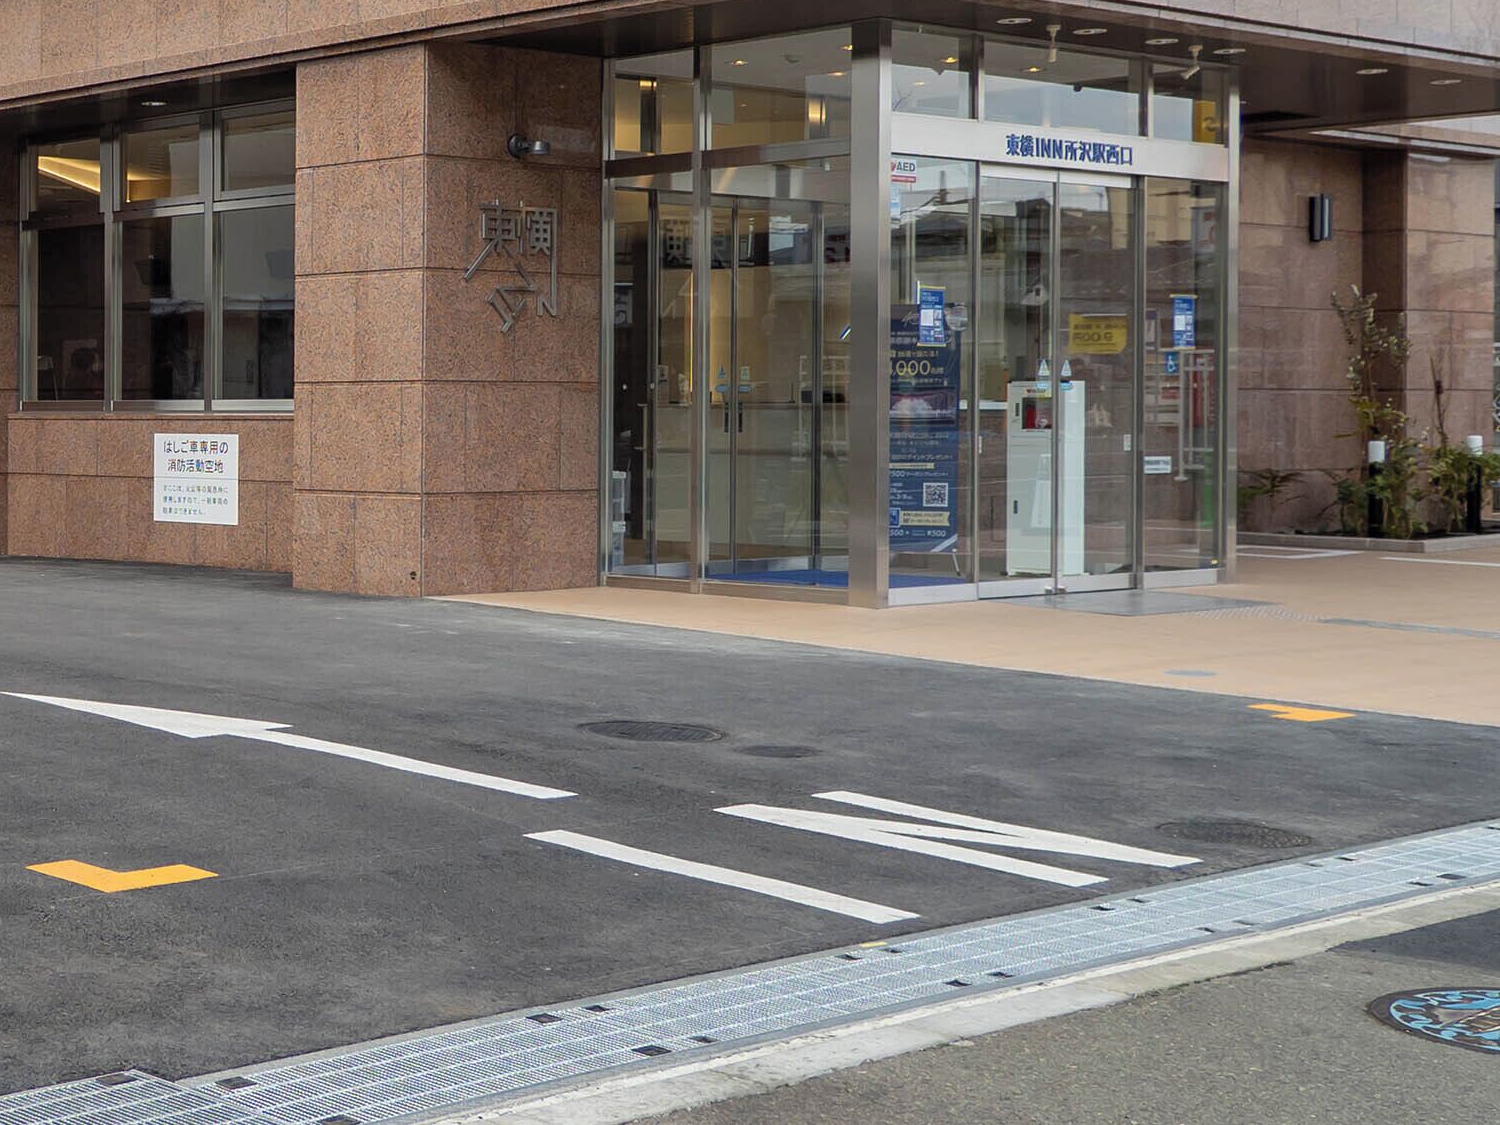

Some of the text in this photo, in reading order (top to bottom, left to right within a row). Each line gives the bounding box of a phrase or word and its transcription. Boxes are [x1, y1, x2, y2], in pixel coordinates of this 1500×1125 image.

[896, 161, 916, 173] AED
[163, 440, 229, 455] はしご車専用の
[167, 459, 224, 474] 消防活動空地
